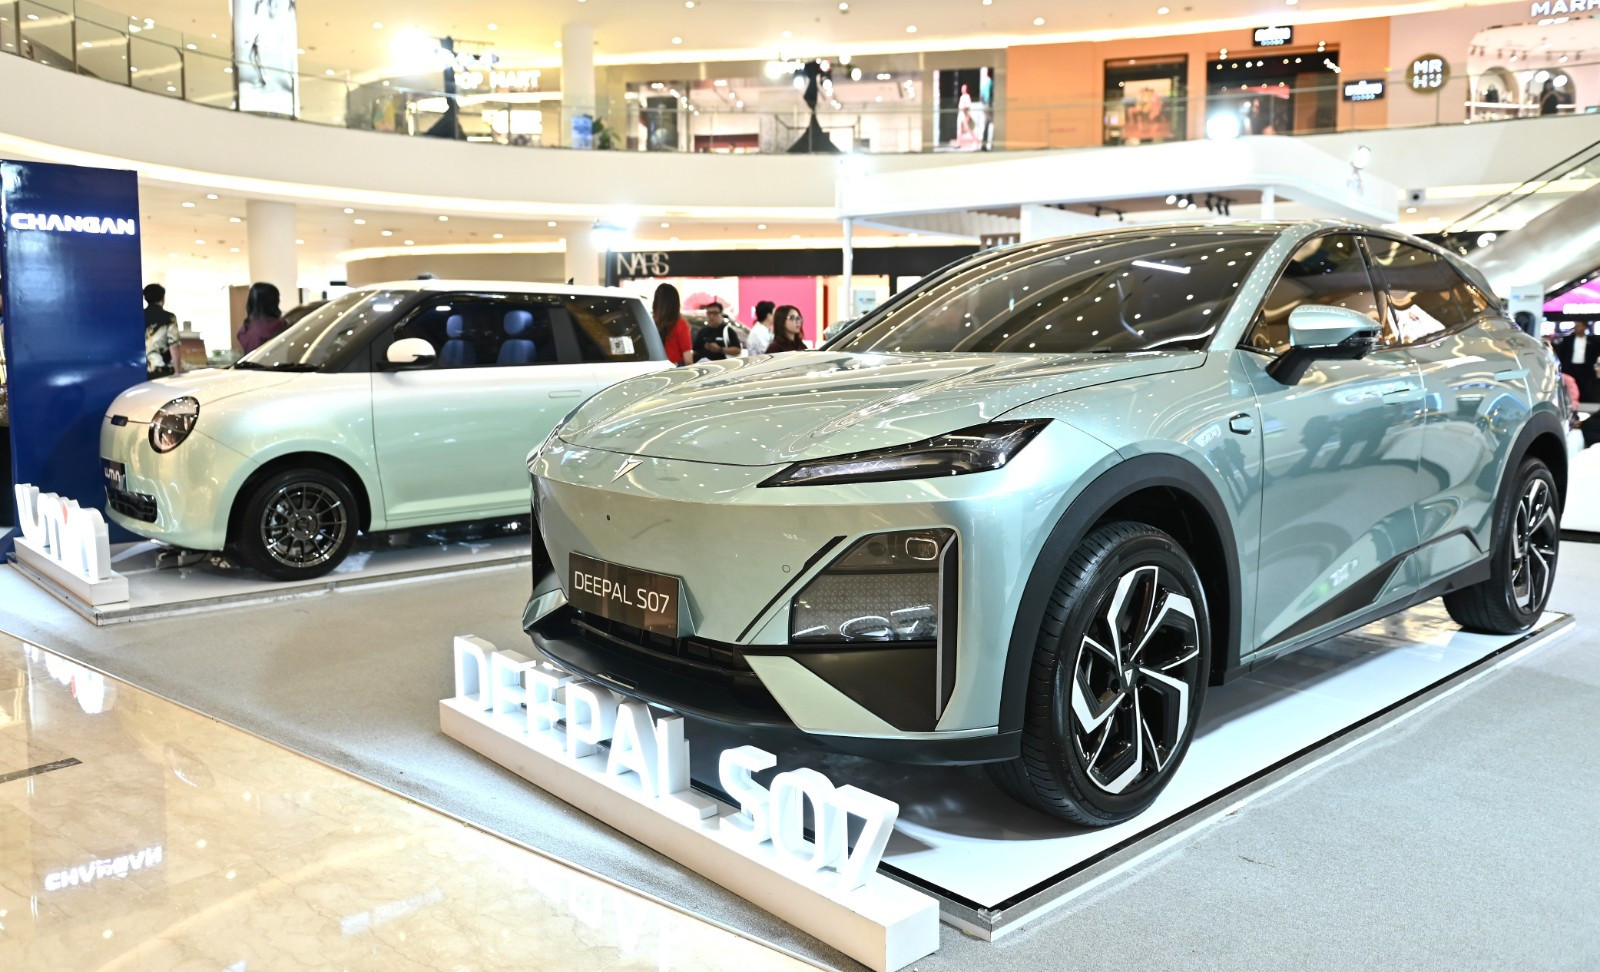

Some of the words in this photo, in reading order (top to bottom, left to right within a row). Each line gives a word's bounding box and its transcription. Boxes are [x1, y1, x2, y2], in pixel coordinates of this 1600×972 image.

[1413, 59, 1443, 74] MR
[10, 212, 135, 235] CHANGAN
[617, 252, 669, 276] NARS
[574, 570, 632, 605] DEEPAL
[636, 588, 670, 613] S07
[454, 634, 718, 820] DEEPAL
[719, 744, 899, 892] S07
